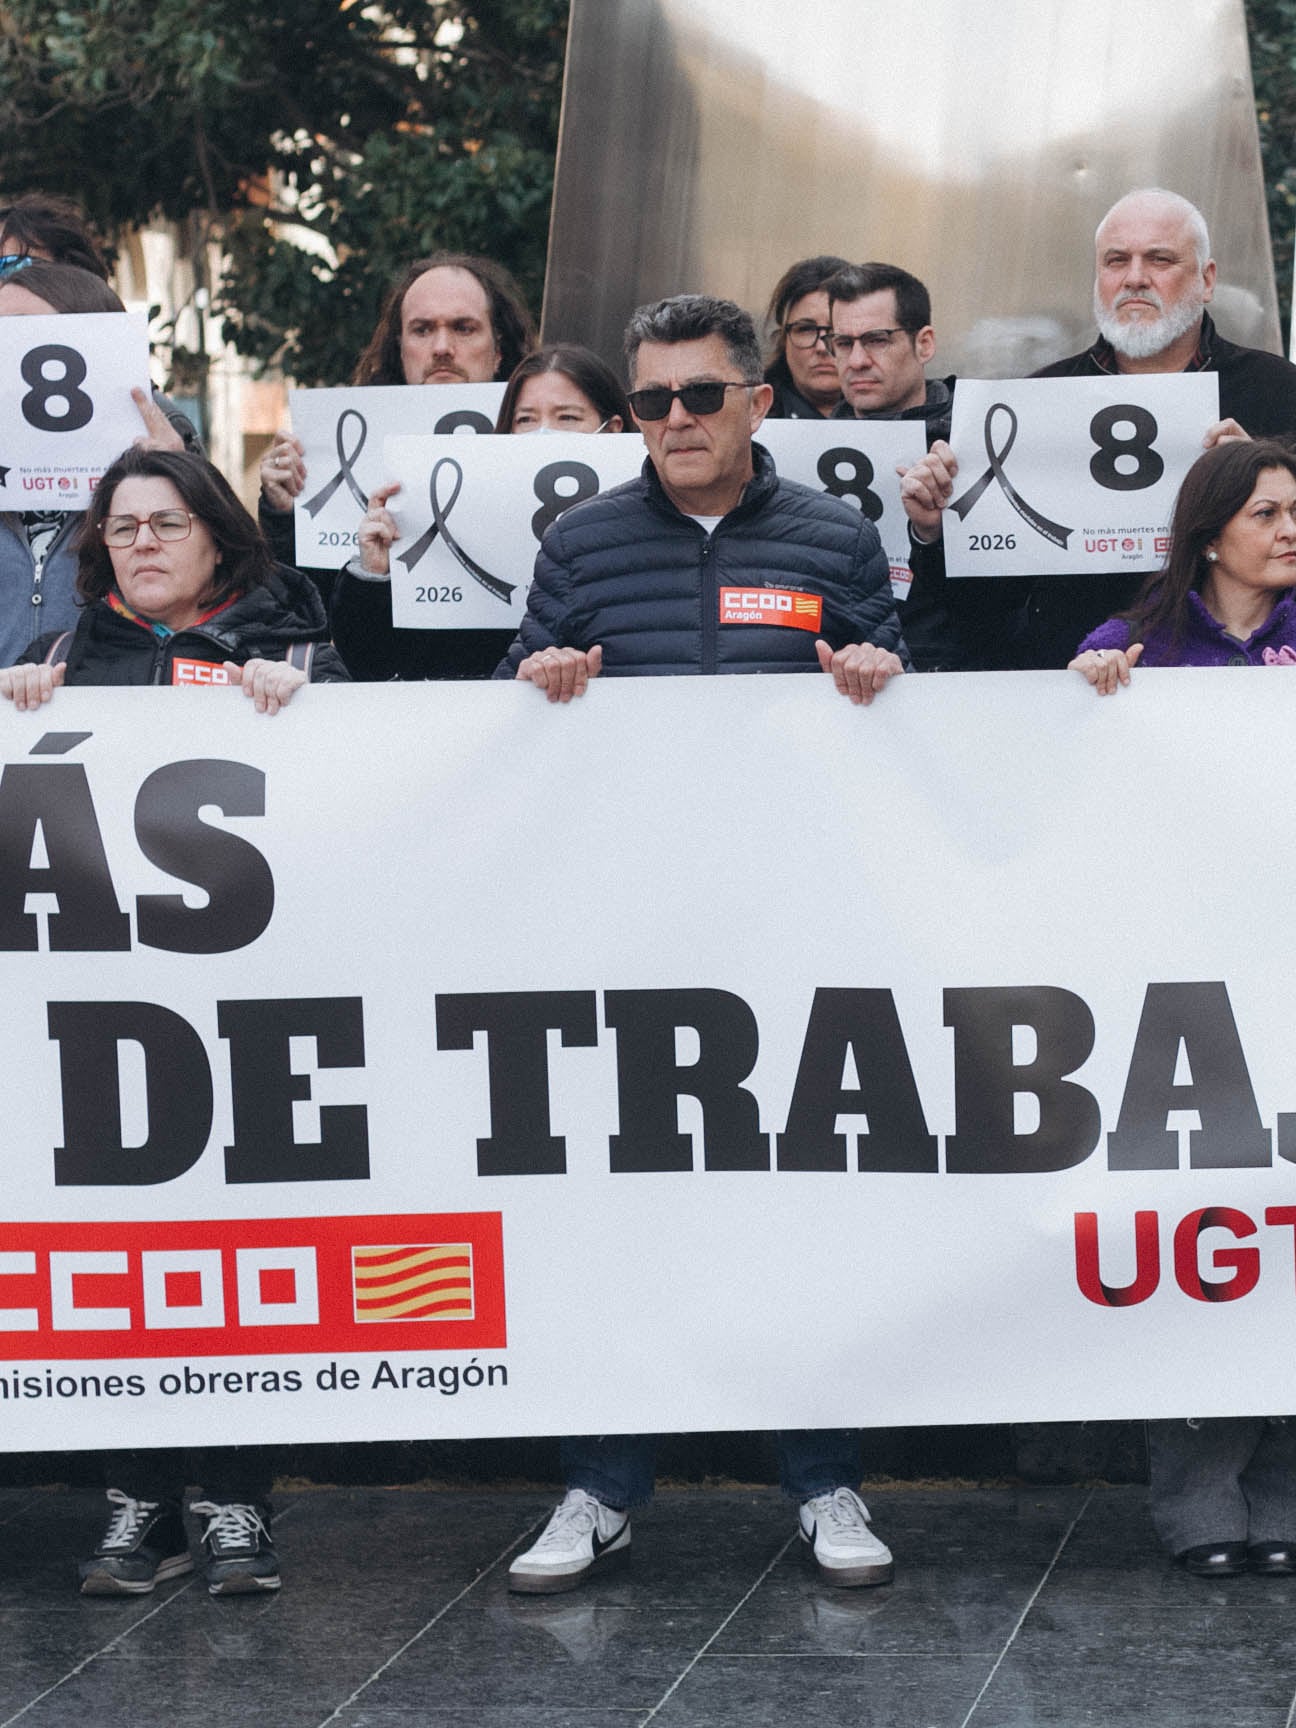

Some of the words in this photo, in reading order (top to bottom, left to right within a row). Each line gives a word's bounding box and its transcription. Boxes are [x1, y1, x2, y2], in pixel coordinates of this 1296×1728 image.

[20, 344, 94, 432] 8
[1089, 404, 1165, 491] 8
[22, 477, 54, 490] UGT
[817, 447, 884, 522] 8
[531, 460, 600, 543] 8
[968, 533, 1016, 550] 2026
[1085, 538, 1118, 552] UGT
[415, 586, 463, 602] 2026
[724, 592, 792, 611] CCOO
[725, 610, 763, 620] Aragón
[177, 663, 232, 684] CCO
[0, 731, 275, 955] ÁS
[46, 996, 371, 1186] DE
[159, 1365, 301, 1395] obreras
[315, 1362, 360, 1391] de
[372, 1358, 509, 1395] Aragón
